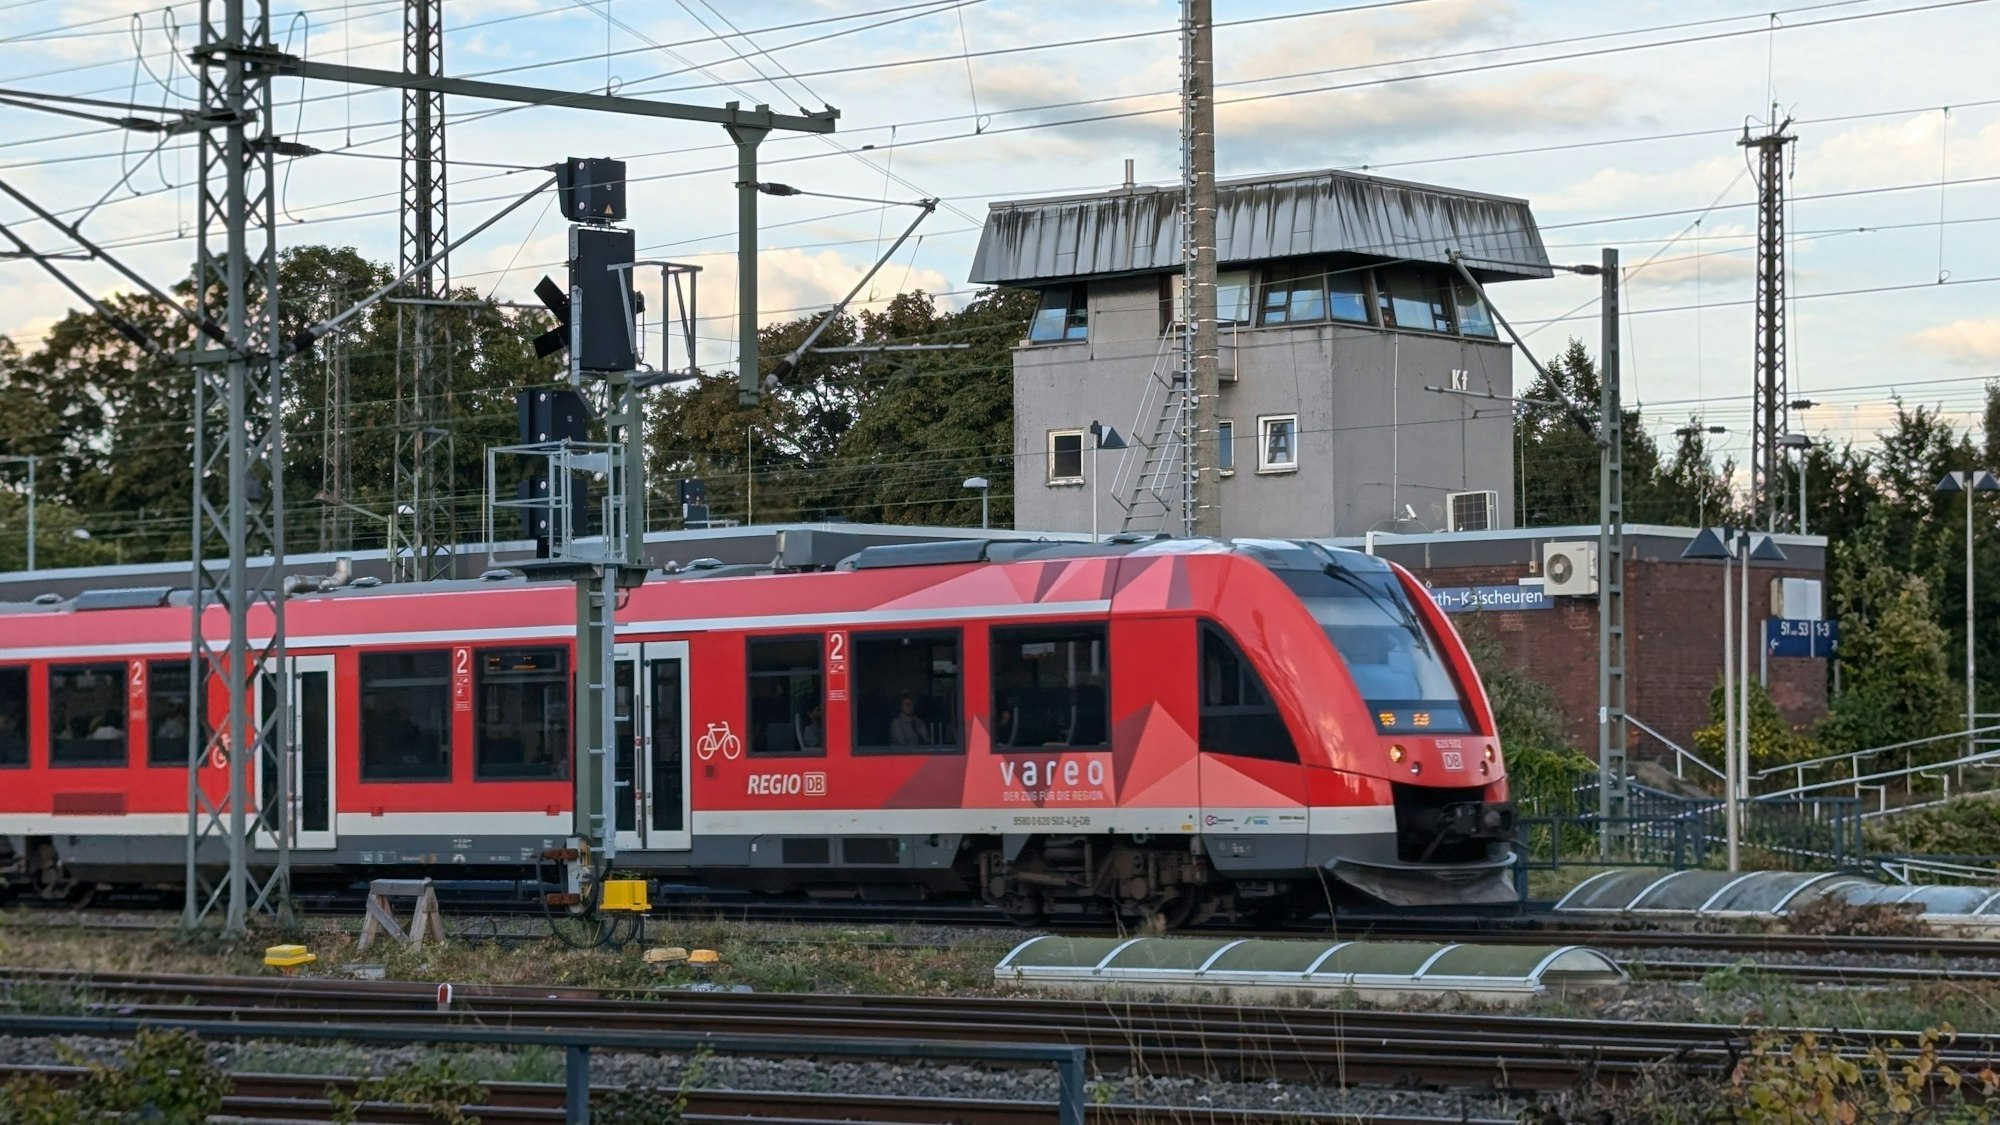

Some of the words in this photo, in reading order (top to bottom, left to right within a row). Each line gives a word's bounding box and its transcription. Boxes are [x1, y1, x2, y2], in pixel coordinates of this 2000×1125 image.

[830, 633, 844, 660] 2
[131, 661, 142, 685] 2
[456, 649, 468, 674] 2
[1444, 753, 1462, 768] DB
[747, 774, 801, 795] REGIO
[806, 775, 824, 793] DB
[1000, 760, 1104, 786] vareo
[1003, 791, 1020, 801] DER
[1021, 791, 1038, 800] ZUG
[1056, 790, 1070, 800] DIE
[1072, 790, 1104, 800] REGION
